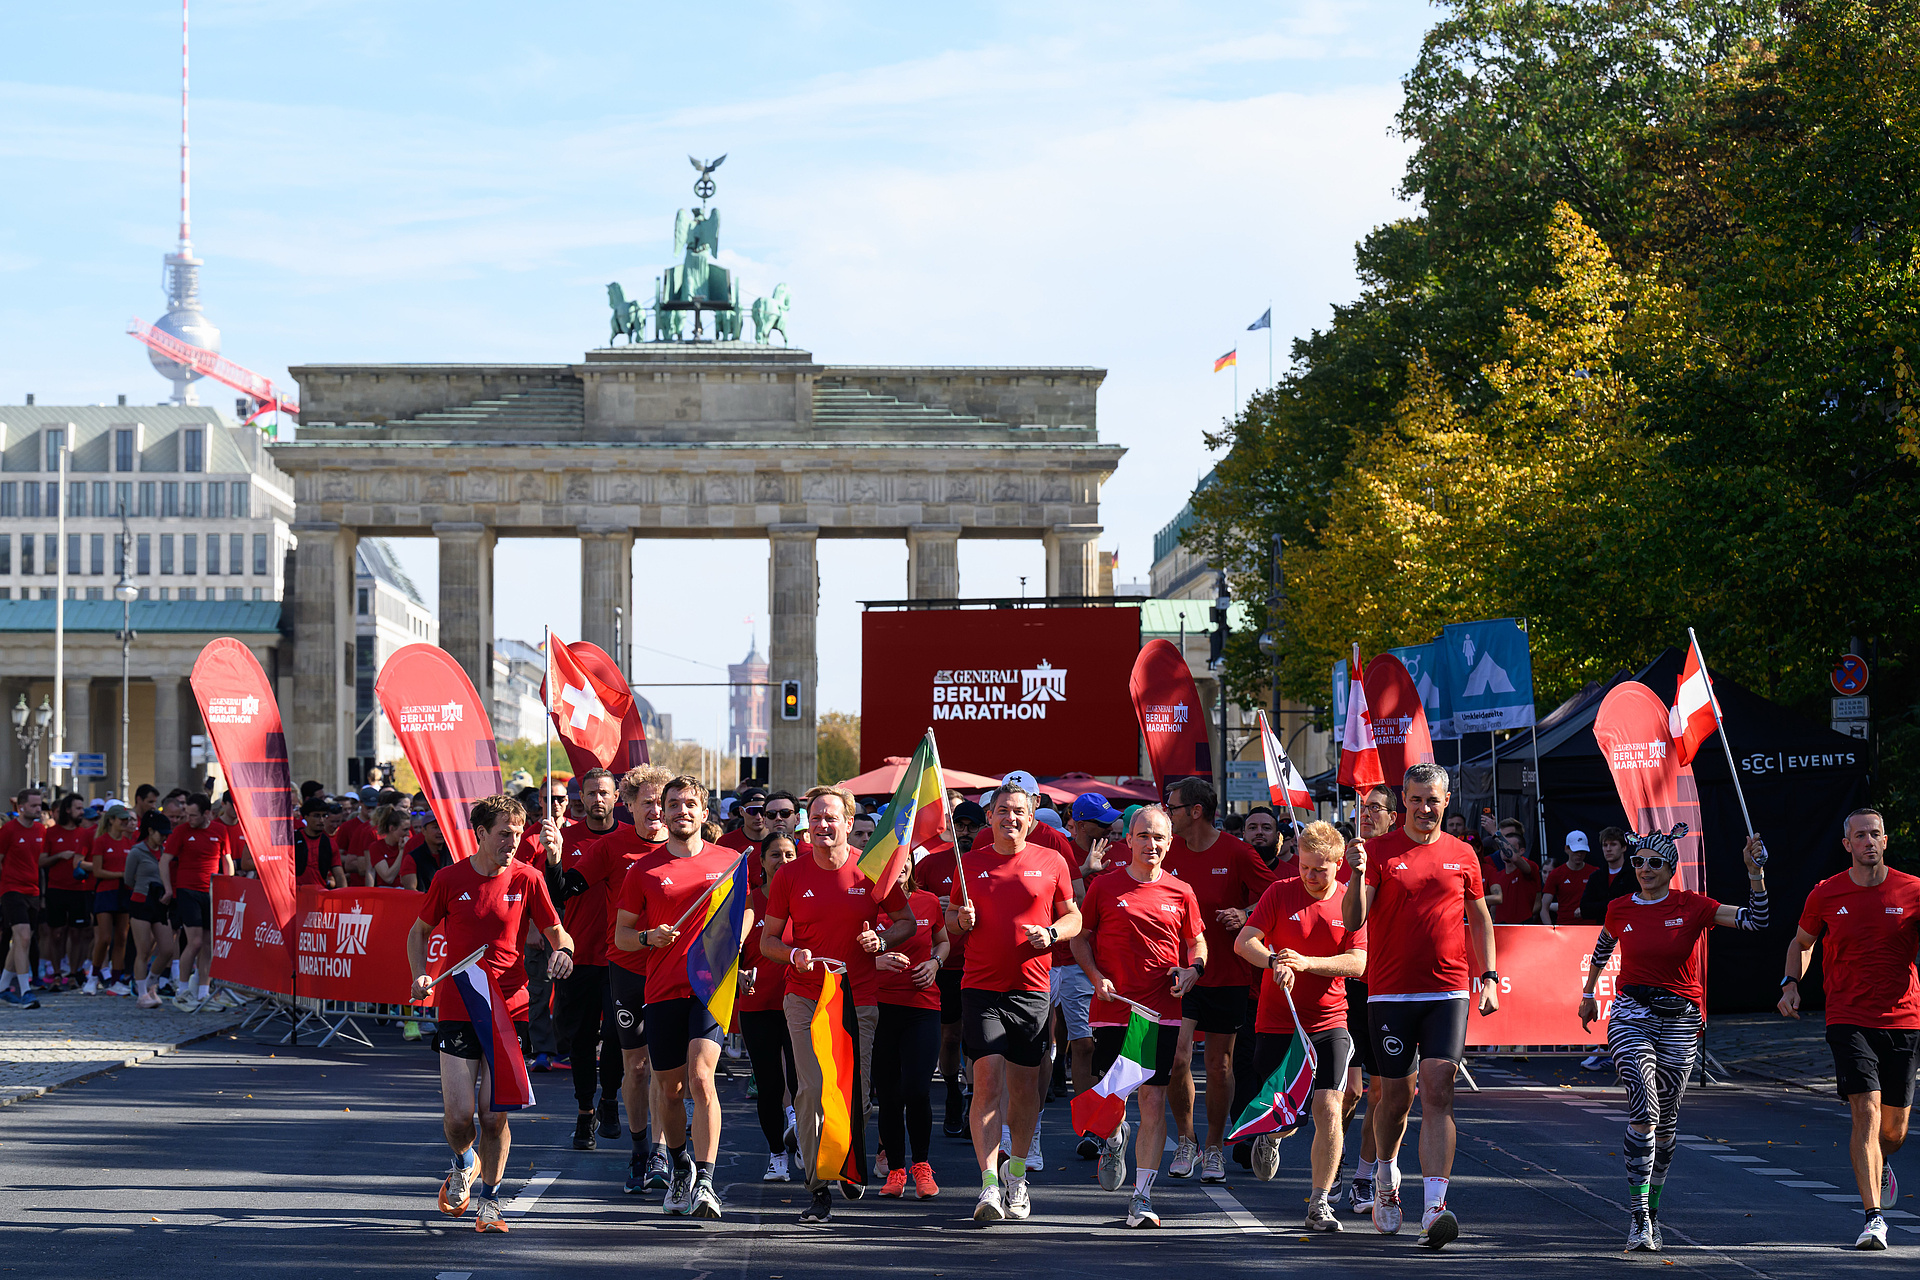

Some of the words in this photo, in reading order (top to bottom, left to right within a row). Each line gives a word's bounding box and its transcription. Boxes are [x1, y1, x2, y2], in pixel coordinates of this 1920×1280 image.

[953, 669, 1019, 684] GENERALI
[933, 686, 1006, 702] BERLIN
[208, 705, 237, 715] BERLIN
[409, 705, 441, 714] GENERALI
[933, 703, 1046, 720] MARATHON
[209, 714, 252, 724] MARATHON
[400, 713, 435, 723] BERLIN
[1145, 713, 1170, 723] BERLIN
[1461, 710, 1504, 721] Umkleidezelte
[400, 722, 455, 732] MARATHON
[1146, 723, 1182, 733] MARATHON
[1373, 726, 1395, 736] BERLIN
[1613, 751, 1644, 761] BERLIN
[1613, 759, 1660, 770] MARATHON
[1741, 753, 1775, 774] SCC
[1787, 753, 1856, 768] EVENTS
[298, 931, 327, 953] BERLIN
[427, 934, 448, 962] CC
[298, 954, 352, 978] MARATHON
